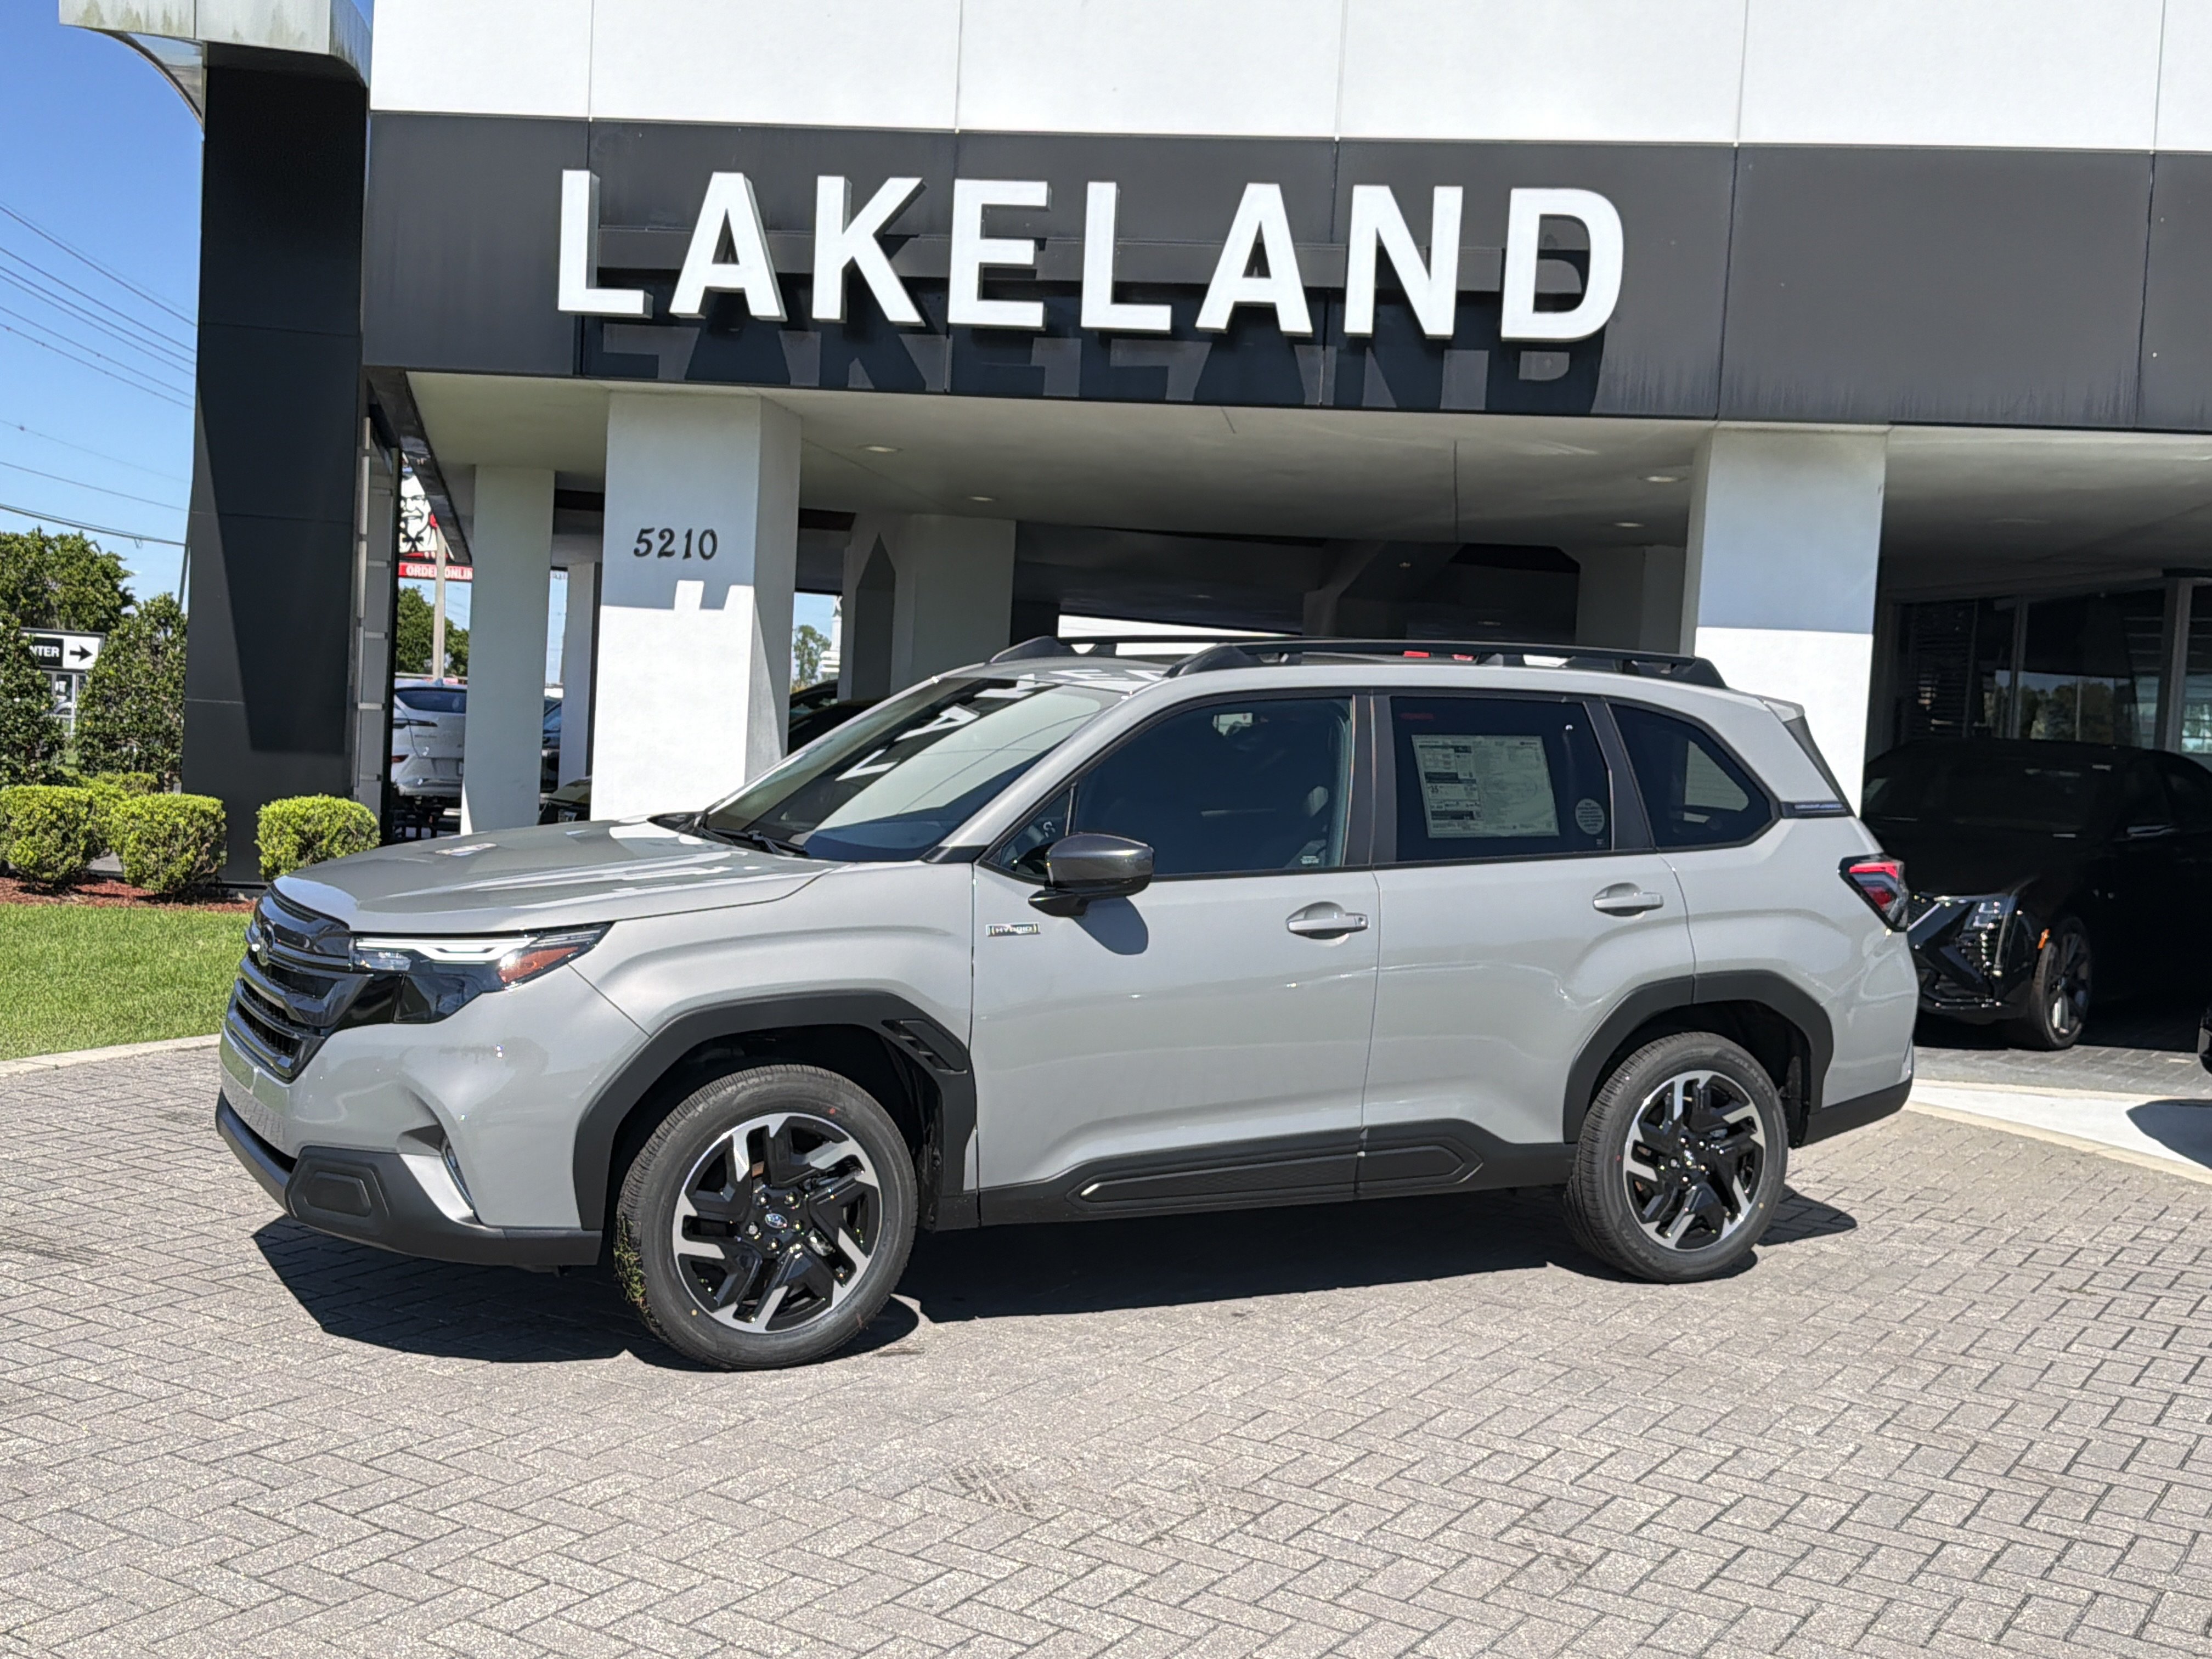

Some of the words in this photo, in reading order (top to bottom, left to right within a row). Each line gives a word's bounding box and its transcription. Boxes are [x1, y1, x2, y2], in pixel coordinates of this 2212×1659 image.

[557, 168, 1625, 343] LAKELAND
[633, 526, 718, 561] 5210
[444, 566, 473, 580] ONLIN
[29, 645, 60, 657] NTER
